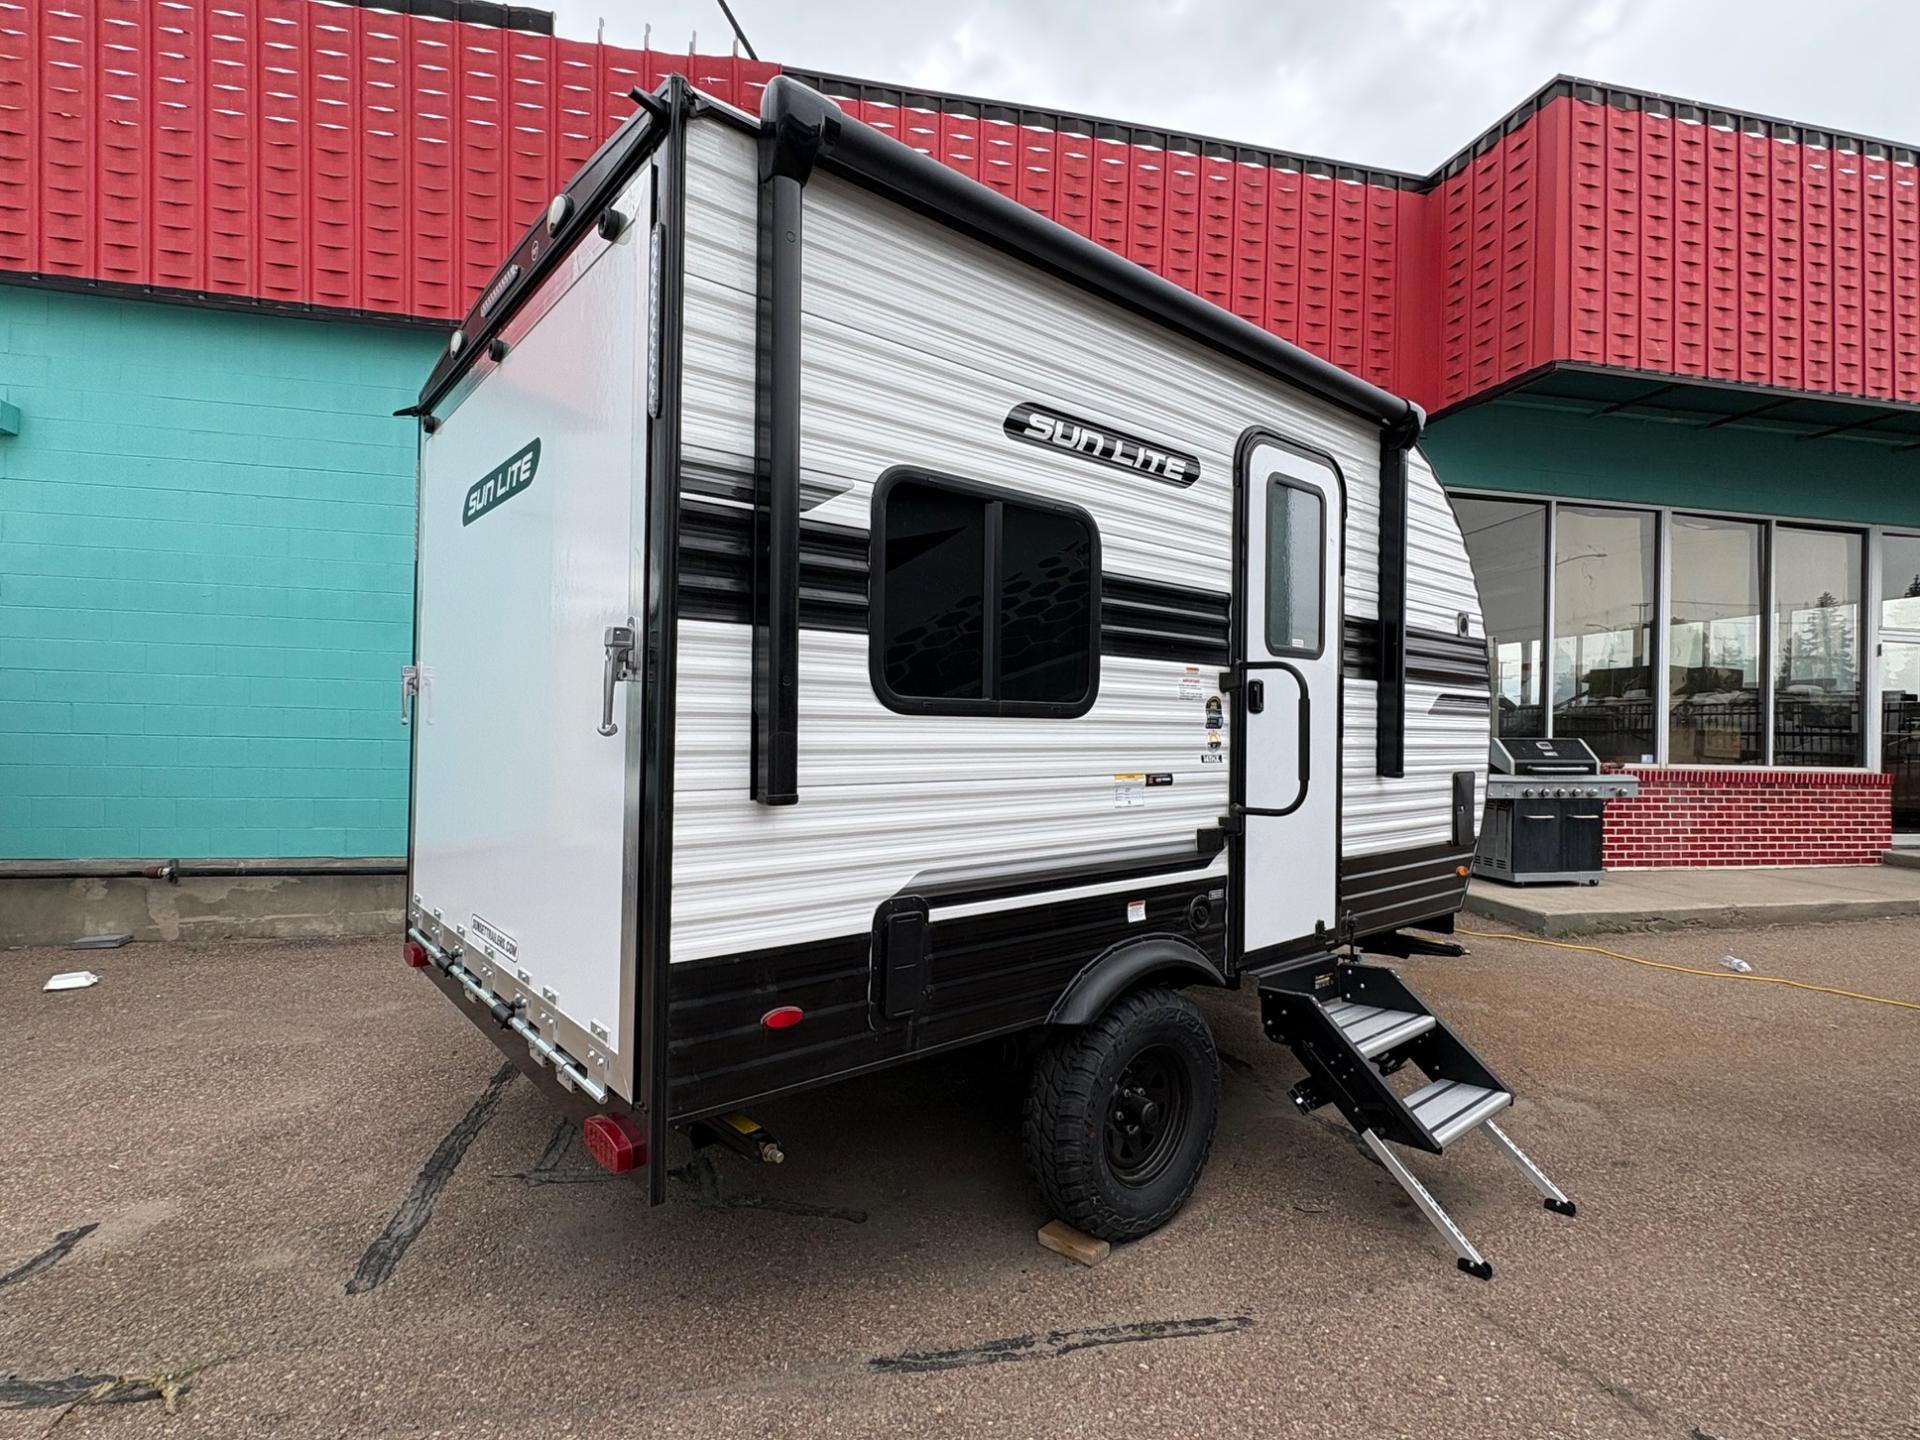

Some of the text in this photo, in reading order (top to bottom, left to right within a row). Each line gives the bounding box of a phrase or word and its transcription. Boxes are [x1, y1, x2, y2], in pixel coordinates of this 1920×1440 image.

[1023, 412, 1187, 481] SUN LITE
[467, 450, 534, 517] SUN LITE
